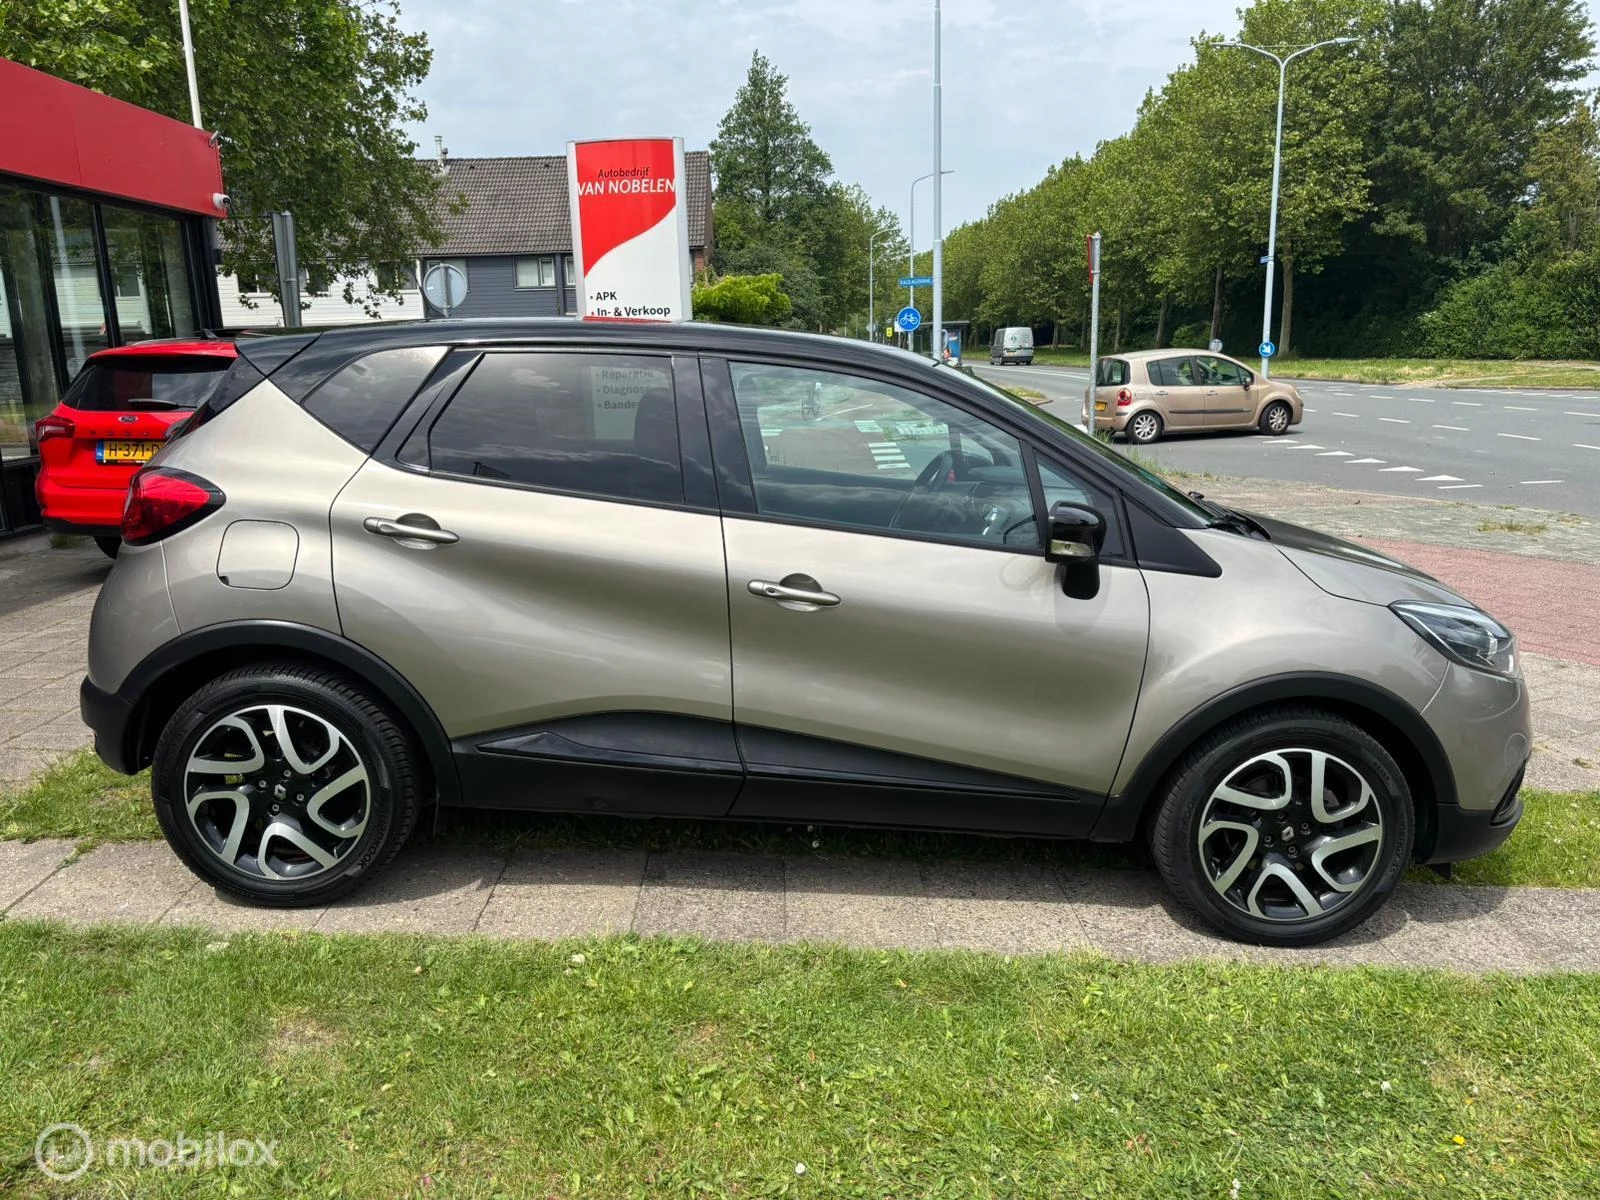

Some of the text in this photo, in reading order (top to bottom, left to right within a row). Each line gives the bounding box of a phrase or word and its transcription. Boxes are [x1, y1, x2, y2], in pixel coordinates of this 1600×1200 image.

[598, 167, 650, 178] Autobedrijf
[577, 178, 676, 196] VAN NOBELEN
[596, 291, 617, 301] APK
[597, 306, 671, 317] In- & Verkoop
[601, 370, 654, 381] Reparatie
[109, 443, 160, 457] H-371-D
